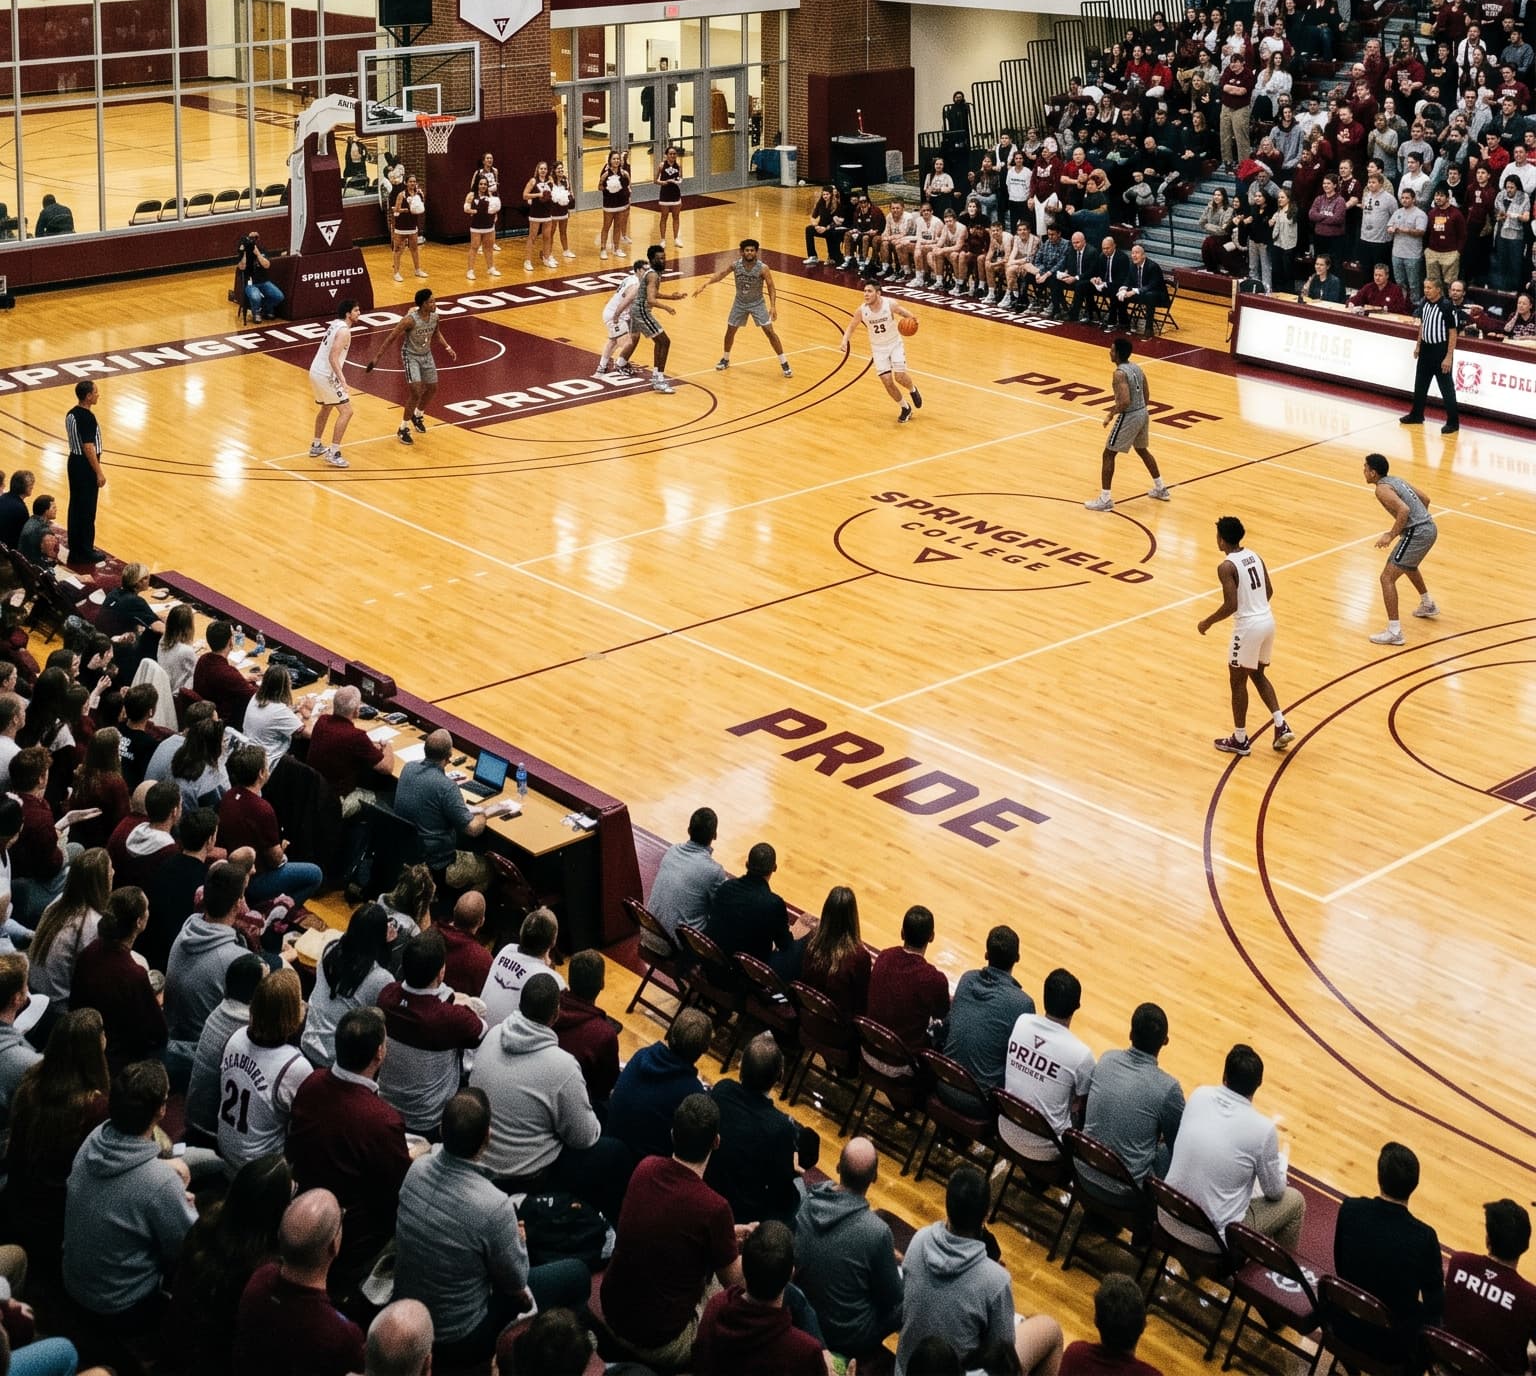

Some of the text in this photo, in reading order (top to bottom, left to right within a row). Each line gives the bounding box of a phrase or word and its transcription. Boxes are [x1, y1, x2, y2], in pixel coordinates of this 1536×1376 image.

[444, 371, 644, 416] PRIDE
[871, 491, 1154, 584] SPRINGFIELD
[901, 522, 1051, 572] COLLEGE
[725, 708, 1052, 848] PRIDE
[1009, 1041, 1061, 1079] PRIDE
[221, 1079, 251, 1135] 21
[1454, 1269, 1516, 1310] PRIDE
